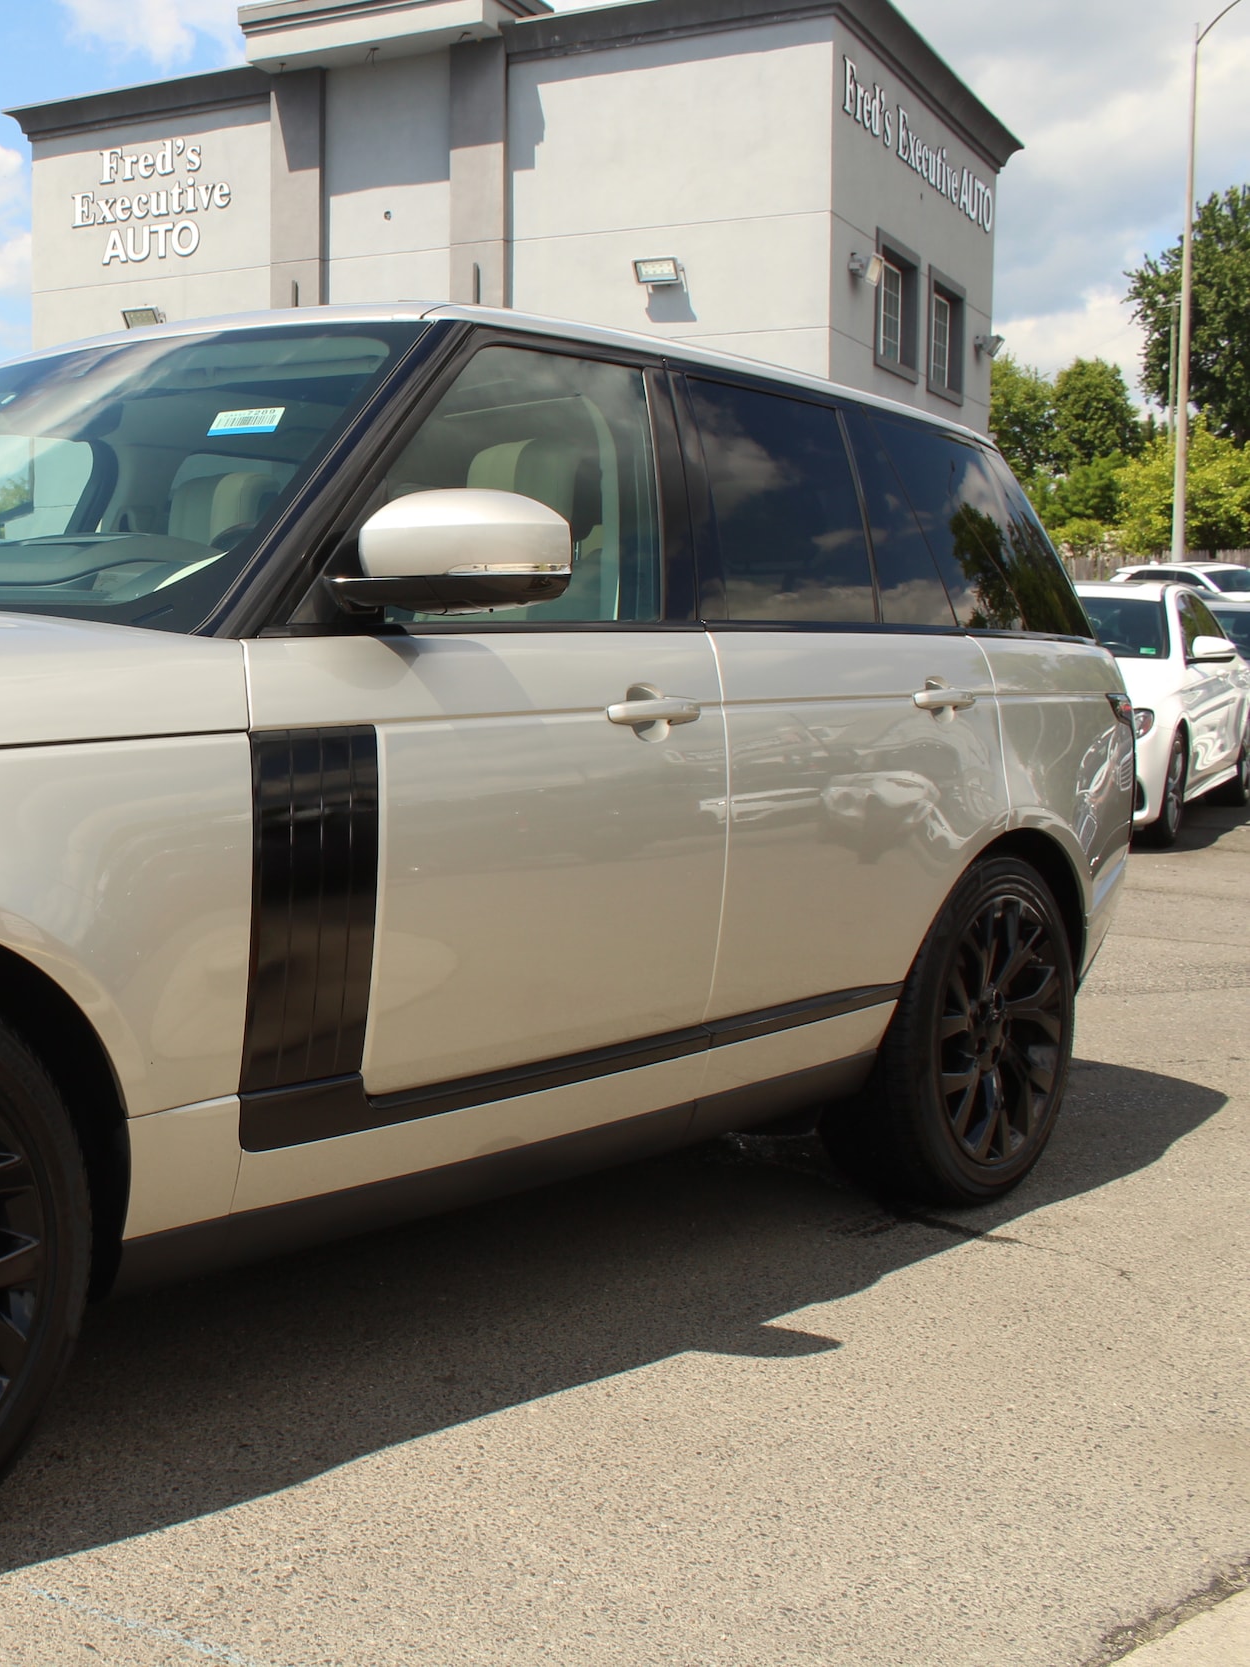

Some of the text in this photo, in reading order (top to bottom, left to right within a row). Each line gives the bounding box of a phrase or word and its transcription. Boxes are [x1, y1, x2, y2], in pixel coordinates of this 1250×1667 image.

[99, 138, 202, 185] Fred's
[843, 55, 993, 233] Fred's Executive AUTO
[71, 177, 232, 229] Executive
[102, 219, 201, 265] AUTO
